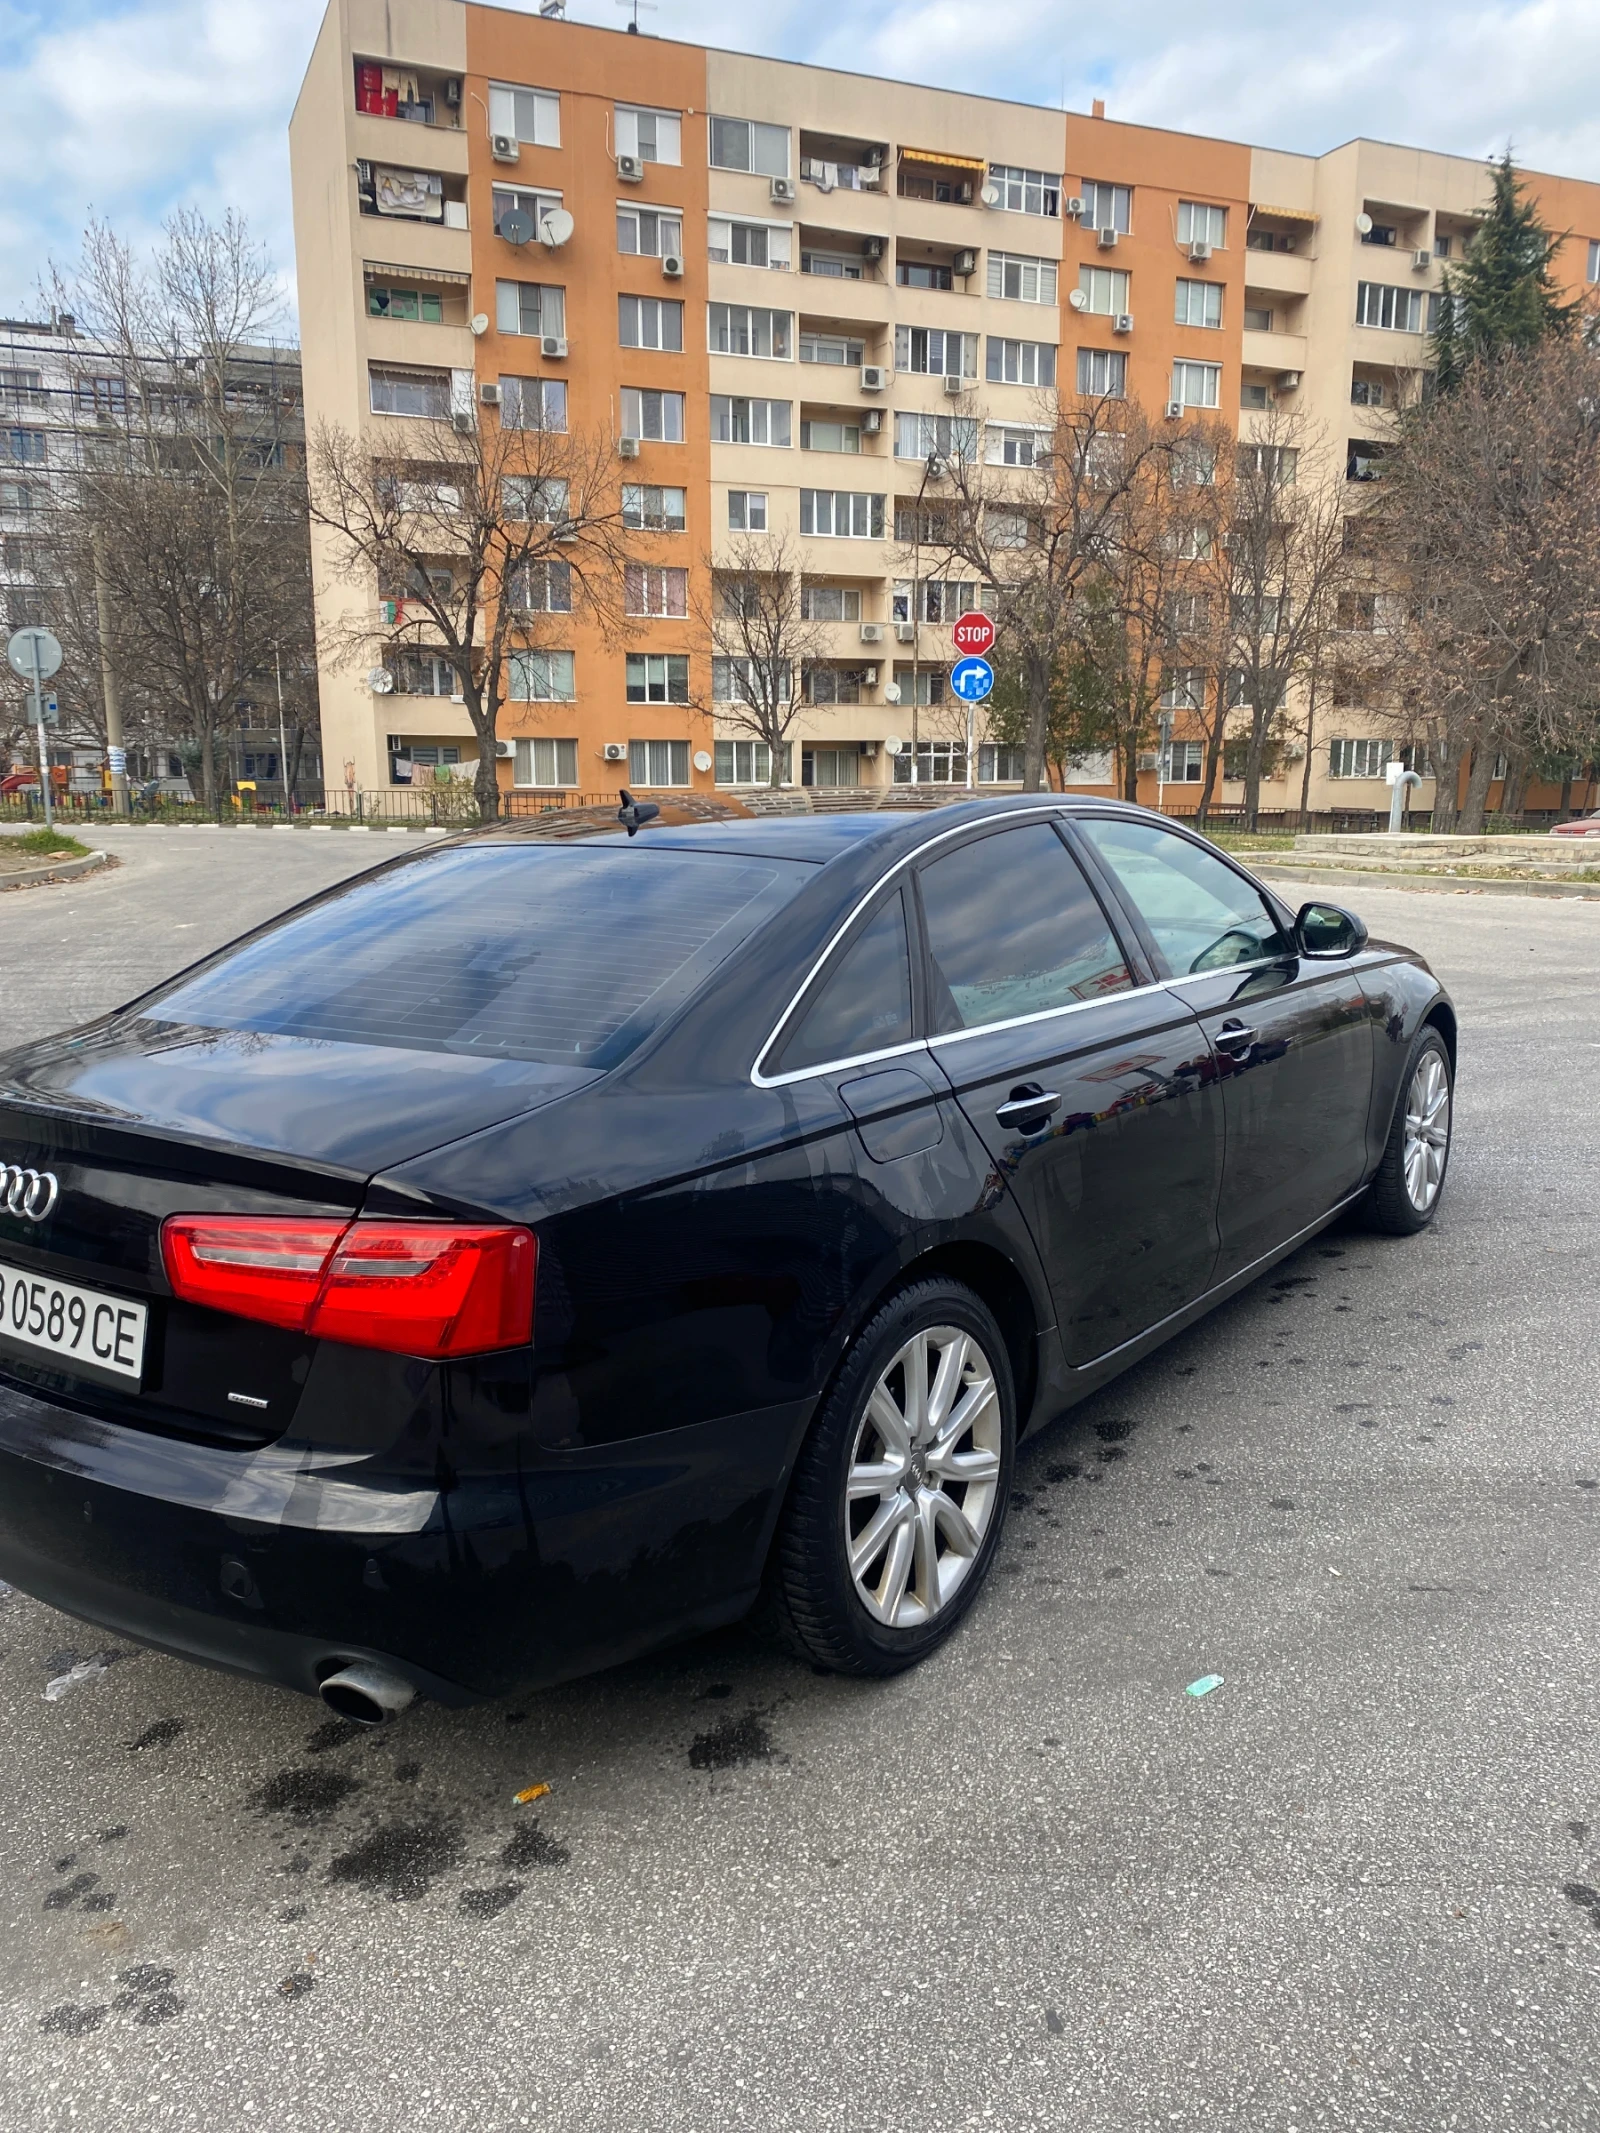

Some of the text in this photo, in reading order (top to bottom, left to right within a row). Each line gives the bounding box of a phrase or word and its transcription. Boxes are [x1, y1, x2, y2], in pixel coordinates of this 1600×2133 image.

[957, 626, 990, 642] STOP
[12, 1279, 86, 1348] 0589
[92, 1303, 137, 1367] CE
